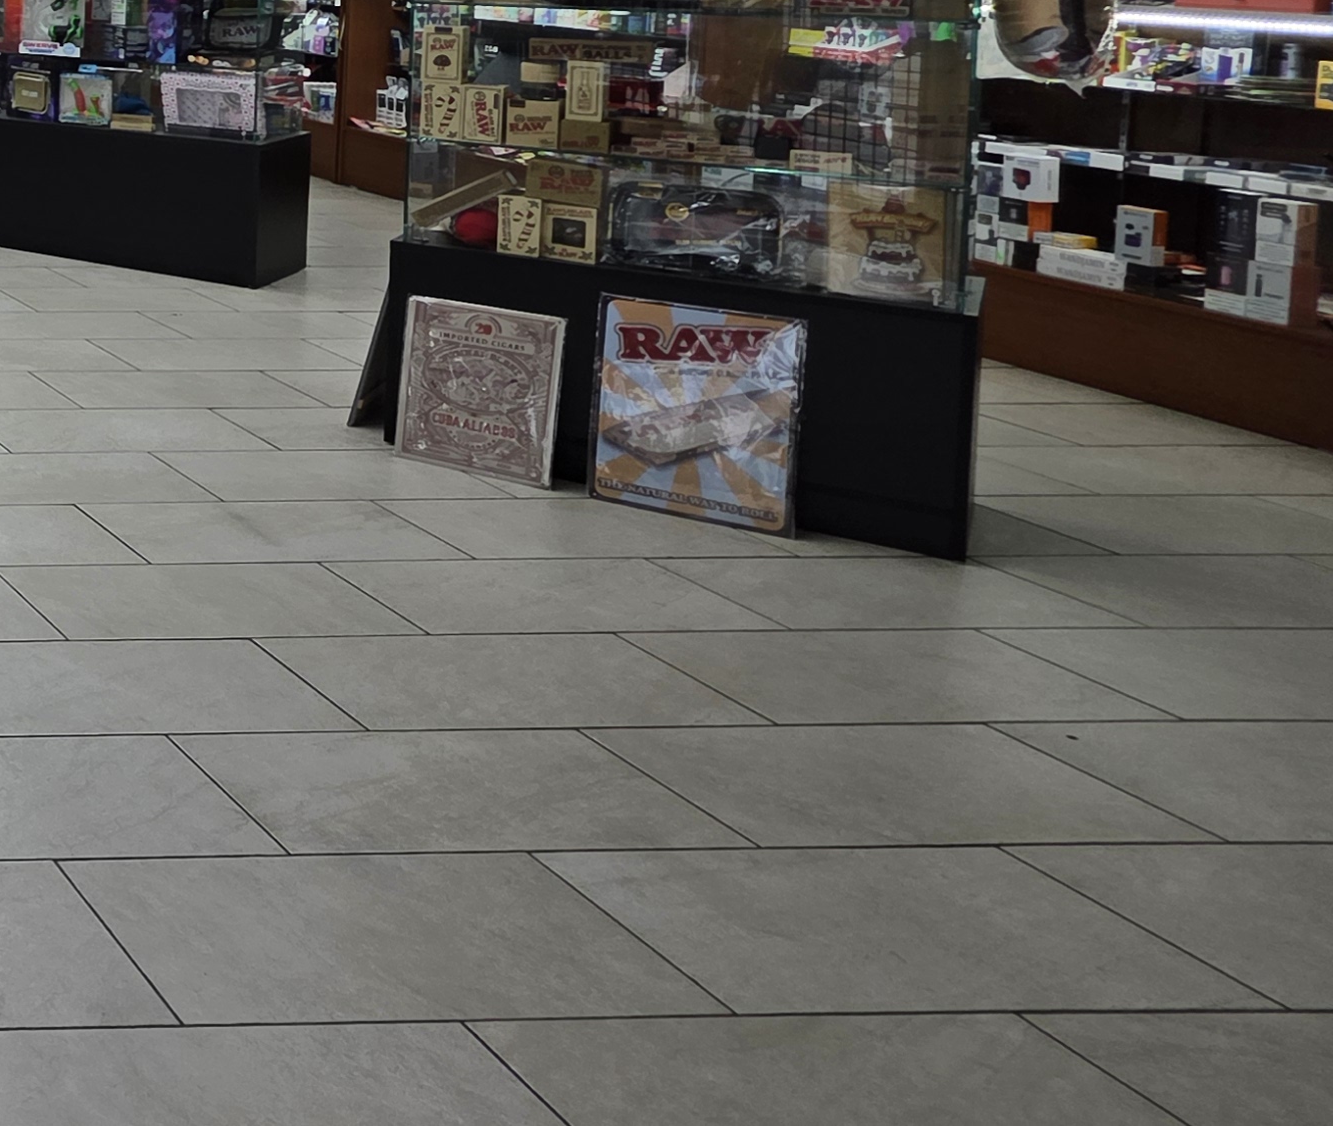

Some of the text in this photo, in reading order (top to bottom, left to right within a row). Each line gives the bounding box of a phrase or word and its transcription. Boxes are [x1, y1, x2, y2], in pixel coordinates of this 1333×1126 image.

[430, 37, 457, 52] RAW
[531, 42, 579, 57] RAW
[509, 119, 549, 132] RAW
[439, 330, 526, 352] IMPORTED CIGARS
[616, 324, 774, 365] RAW
[432, 412, 517, 439] CUBA ALIADOS
[627, 483, 688, 506] NATURAL
[688, 496, 719, 511] WAY
[720, 502, 740, 515] TO
[740, 506, 779, 522] ROLL
